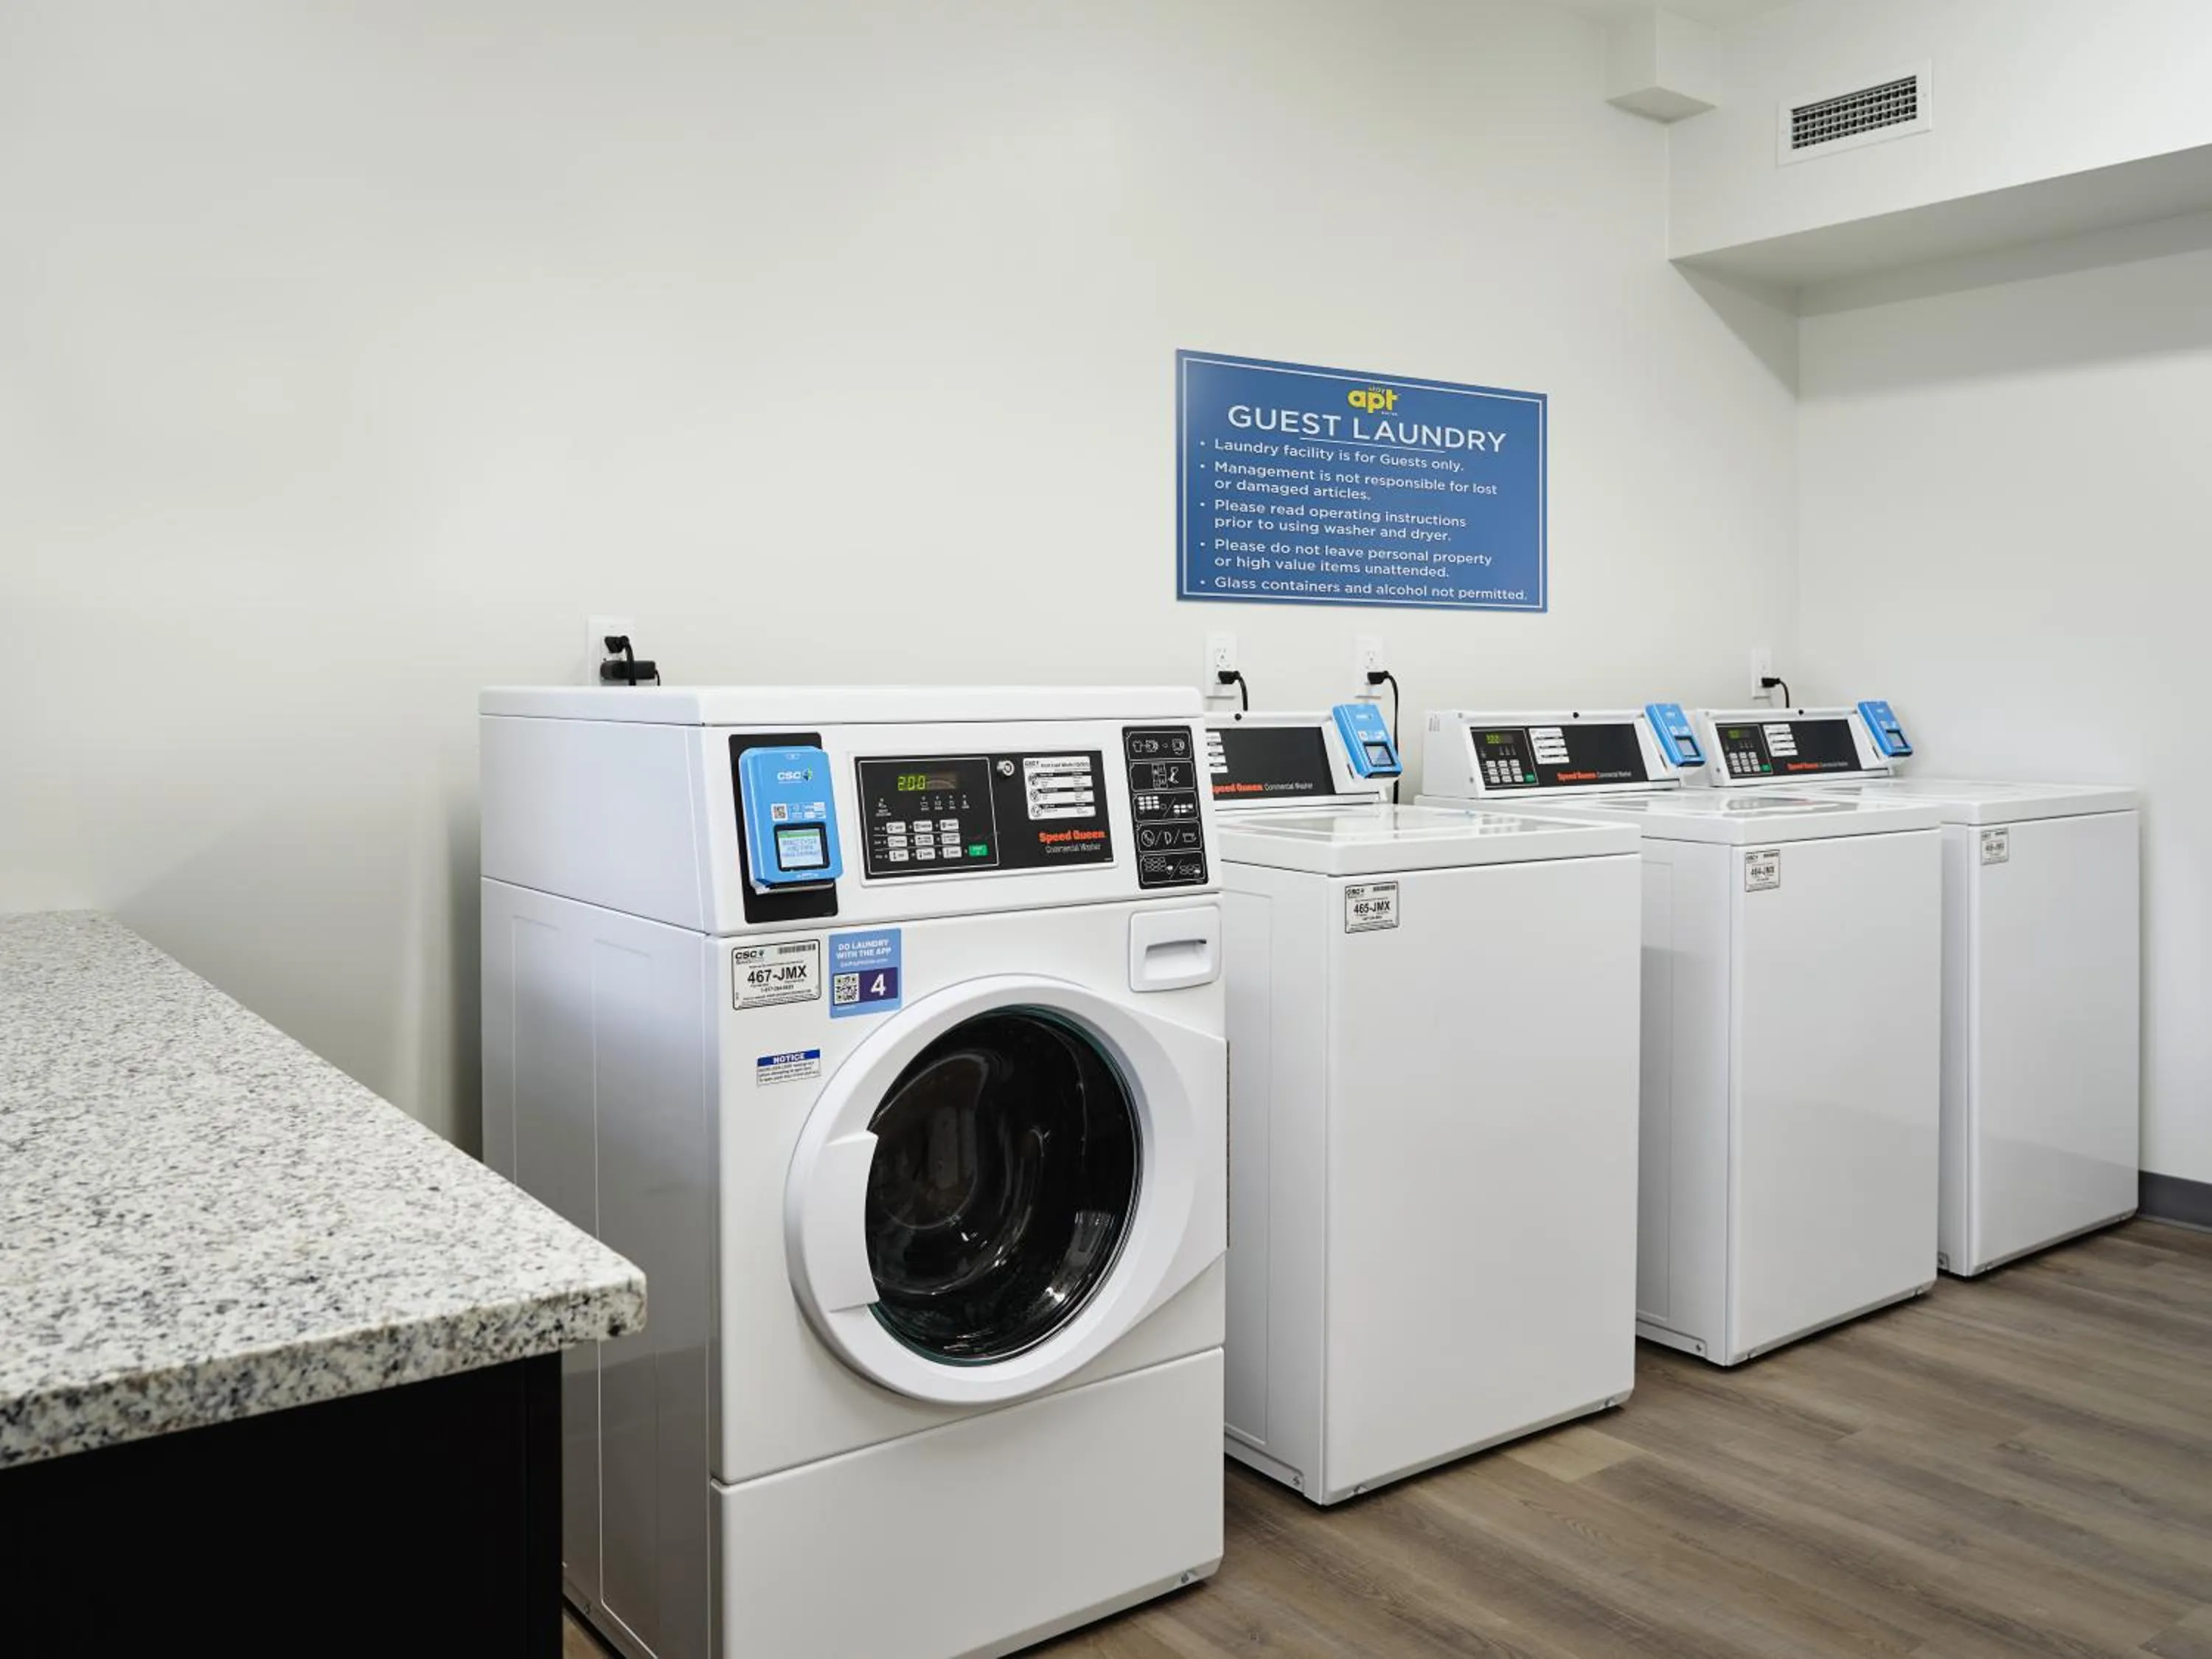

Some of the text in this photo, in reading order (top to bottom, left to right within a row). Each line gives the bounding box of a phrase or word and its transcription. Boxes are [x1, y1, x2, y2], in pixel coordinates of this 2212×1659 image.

[1348, 389, 1399, 414] apt
[1228, 405, 1506, 452] GUEST LAUNDRY
[1215, 439, 1464, 472] Laundry facility is for Guests only.
[1215, 462, 1498, 495] Management is not responsible for lost
[1215, 479, 1371, 500] or damaged articles.
[1215, 499, 1467, 527] Please read operating instructions
[1215, 516, 1451, 542] prior to using washer and dryer.
[1215, 539, 1492, 566] Please do not leave personal property
[1215, 556, 1450, 577] or high value items unattended.
[1214, 577, 1527, 600] Glass containers and alcohol not permitted.
[777, 771, 801, 781] CSC
[1237, 783, 1264, 792] Queen
[1039, 830, 1105, 844] Speed Queen
[1354, 901, 1391, 914] 465-JMX
[735, 950, 757, 959] CSC
[836, 947, 891, 959] WITH THE APP
[852, 939, 888, 949] LAUNDRY
[748, 965, 807, 984] 467-JMX
[871, 973, 886, 996] 4
[773, 1053, 804, 1064] NOTICE
